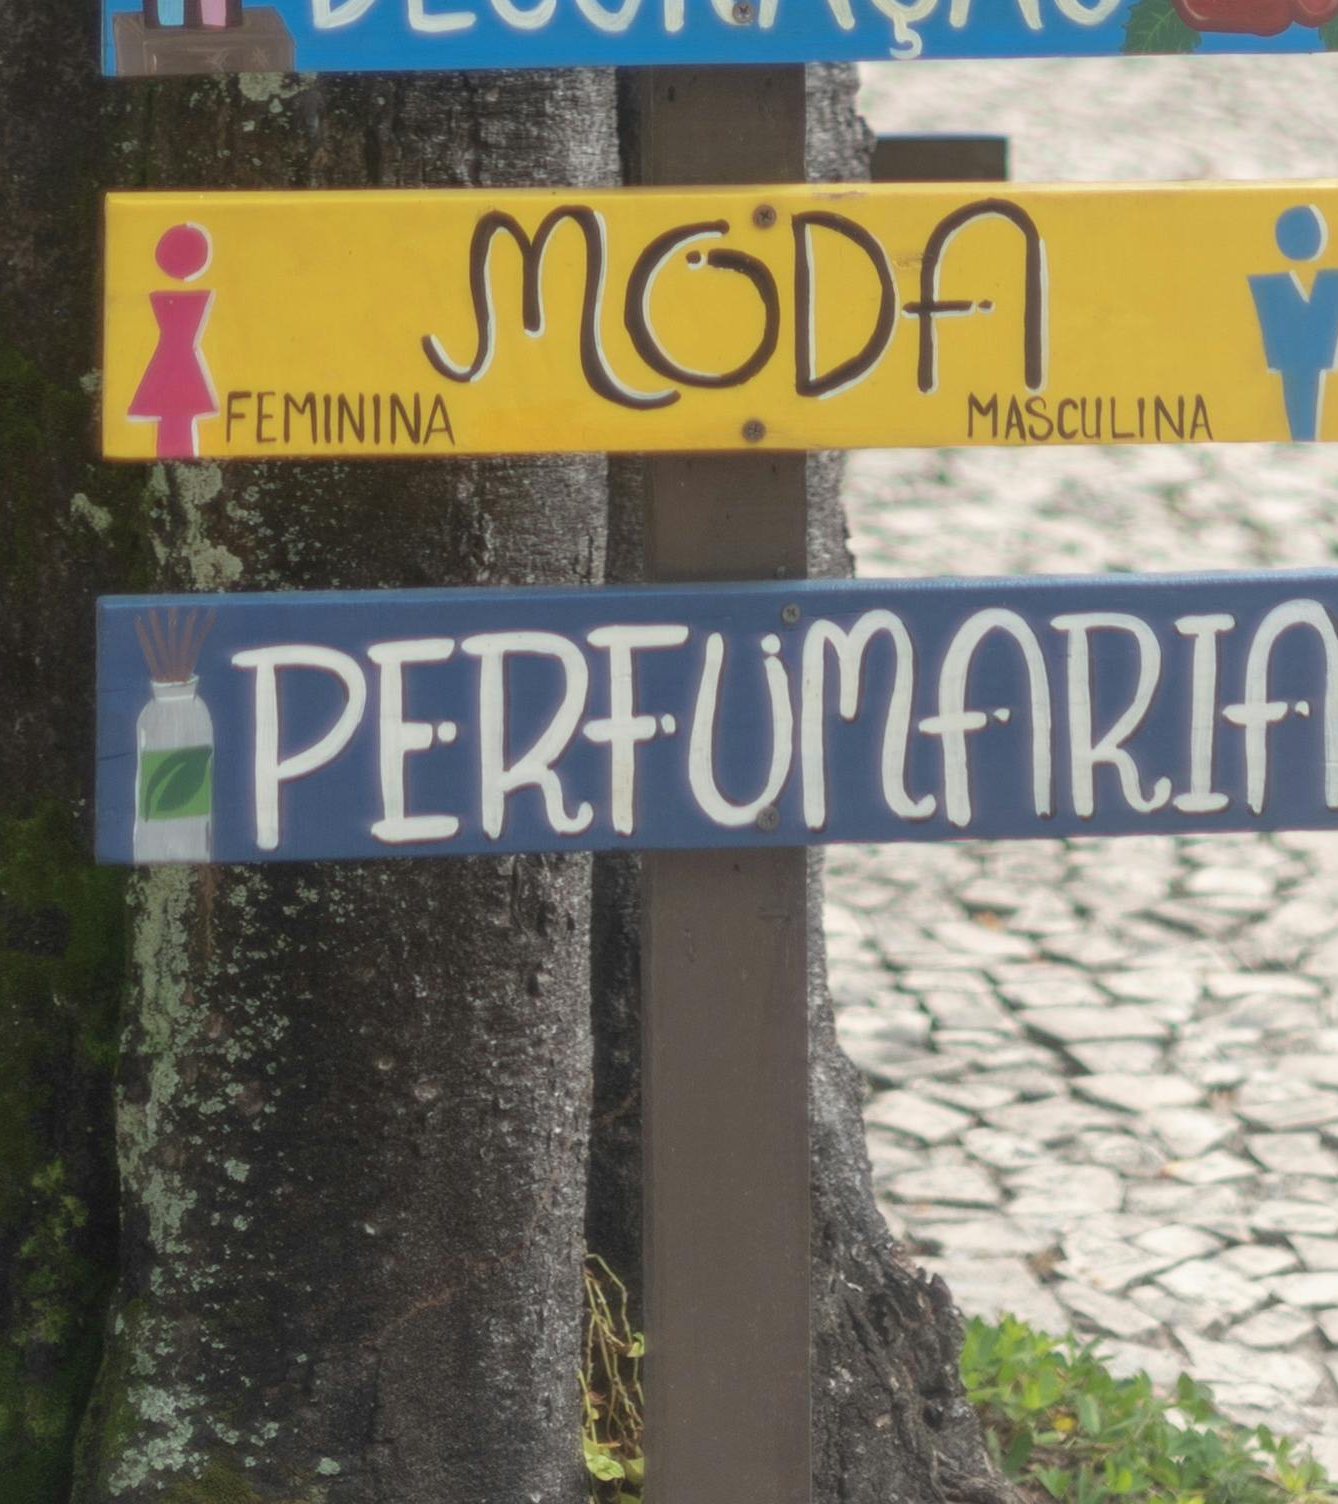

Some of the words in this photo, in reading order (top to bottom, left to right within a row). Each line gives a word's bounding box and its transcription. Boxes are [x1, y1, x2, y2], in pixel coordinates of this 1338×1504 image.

[421, 197, 1052, 411] MODA
[225, 391, 455, 445] FEMININA
[967, 392, 1213, 442] MASCULINA
